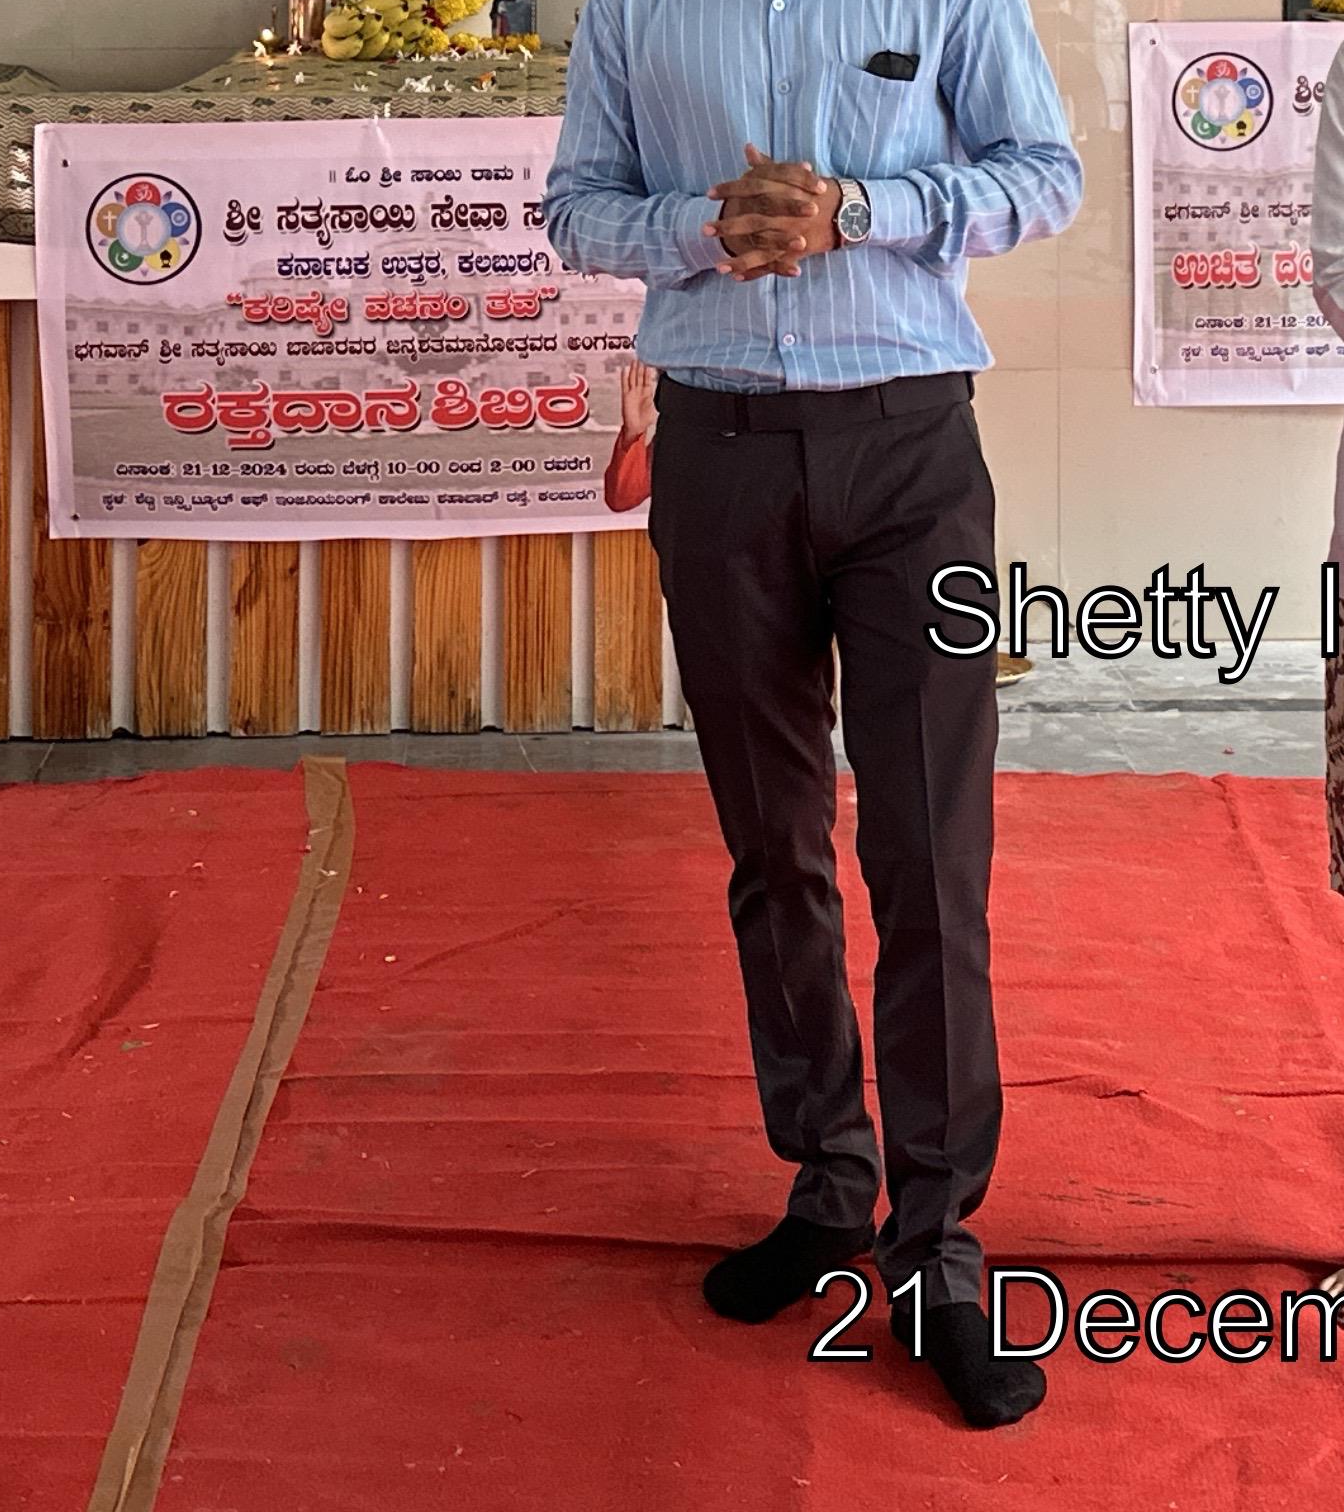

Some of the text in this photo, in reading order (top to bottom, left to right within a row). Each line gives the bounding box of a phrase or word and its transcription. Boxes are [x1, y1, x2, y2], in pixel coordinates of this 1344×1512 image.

[345, 165, 514, 187] ಓಂ ಶ್ರೀ ಸಾಯಿ ರಾಮ
[224, 198, 262, 245] ಶ್ರೀ
[276, 196, 416, 247] ಸತ್ಯಸಾಯಿ
[430, 194, 507, 231] ಸೇವಾ
[1164, 201, 1230, 221] ಭಗವಾನ್
[1239, 201, 1260, 224] ಶ್ರೀ
[276, 250, 370, 278] ಕರ್ನಾಟಕ
[381, 248, 447, 285] ಉತ್ತರ,
[457, 248, 551, 275] ಕಲಬುರಗಿ
[1172, 242, 1261, 287] ಉಚಿತ
[364, 287, 469, 321] ವಚನಂ
[1255, 316, 1332, 329] 21-12-20
[74, 339, 150, 362] ಭಗವಾನ್
[159, 339, 182, 364] ಶ್ರೀ
[191, 339, 277, 366] ಸತ್ಯಸಾಯಿ
[286, 336, 376, 357] ಬಾಬಾರವರ
[162, 373, 590, 450] ರಕ್ತದಾನ ಶಿಬಿರ
[183, 462, 287, 477] 21-12-2024
[295, 461, 335, 476] ರಂದು
[387, 460, 440, 475] 10-00
[490, 459, 536, 474] 2-00
